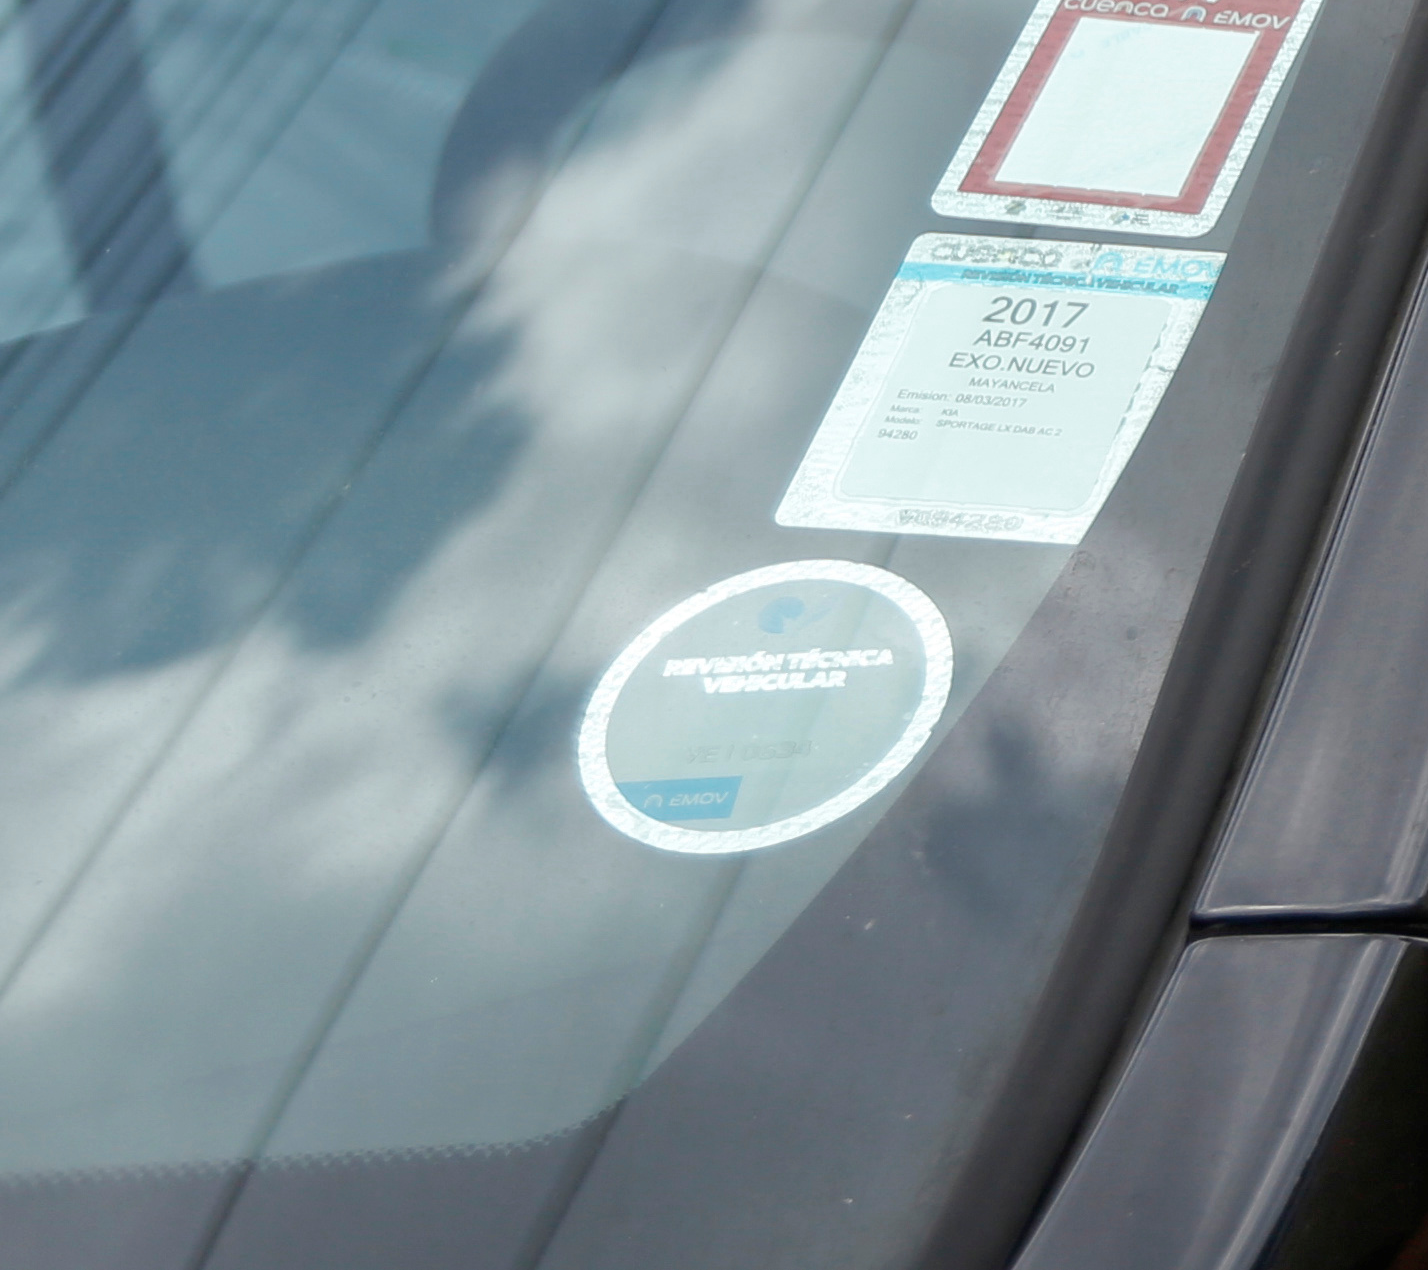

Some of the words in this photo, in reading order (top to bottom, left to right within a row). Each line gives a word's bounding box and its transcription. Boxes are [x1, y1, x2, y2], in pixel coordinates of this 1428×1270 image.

[1213, 9, 1291, 30] EMOV
[982, 296, 1090, 328] 2017
[972, 329, 1090, 354] ABF4091
[949, 352, 1095, 378] EXO.NUEVO
[968, 377, 1055, 393] MAYANCELA
[955, 393, 1027, 408] 08/03/2017
[941, 408, 959, 417] KIA
[877, 428, 919, 441] 94280
[936, 419, 996, 432] SPORTAGE
[997, 423, 1012, 433] LX
[1037, 427, 1053, 436] AC
[662, 651, 785, 677] REVISIÓN
[786, 647, 894, 671] TÉCNICA
[703, 670, 849, 695] VEHICULAR
[668, 790, 730, 808] EMOV
